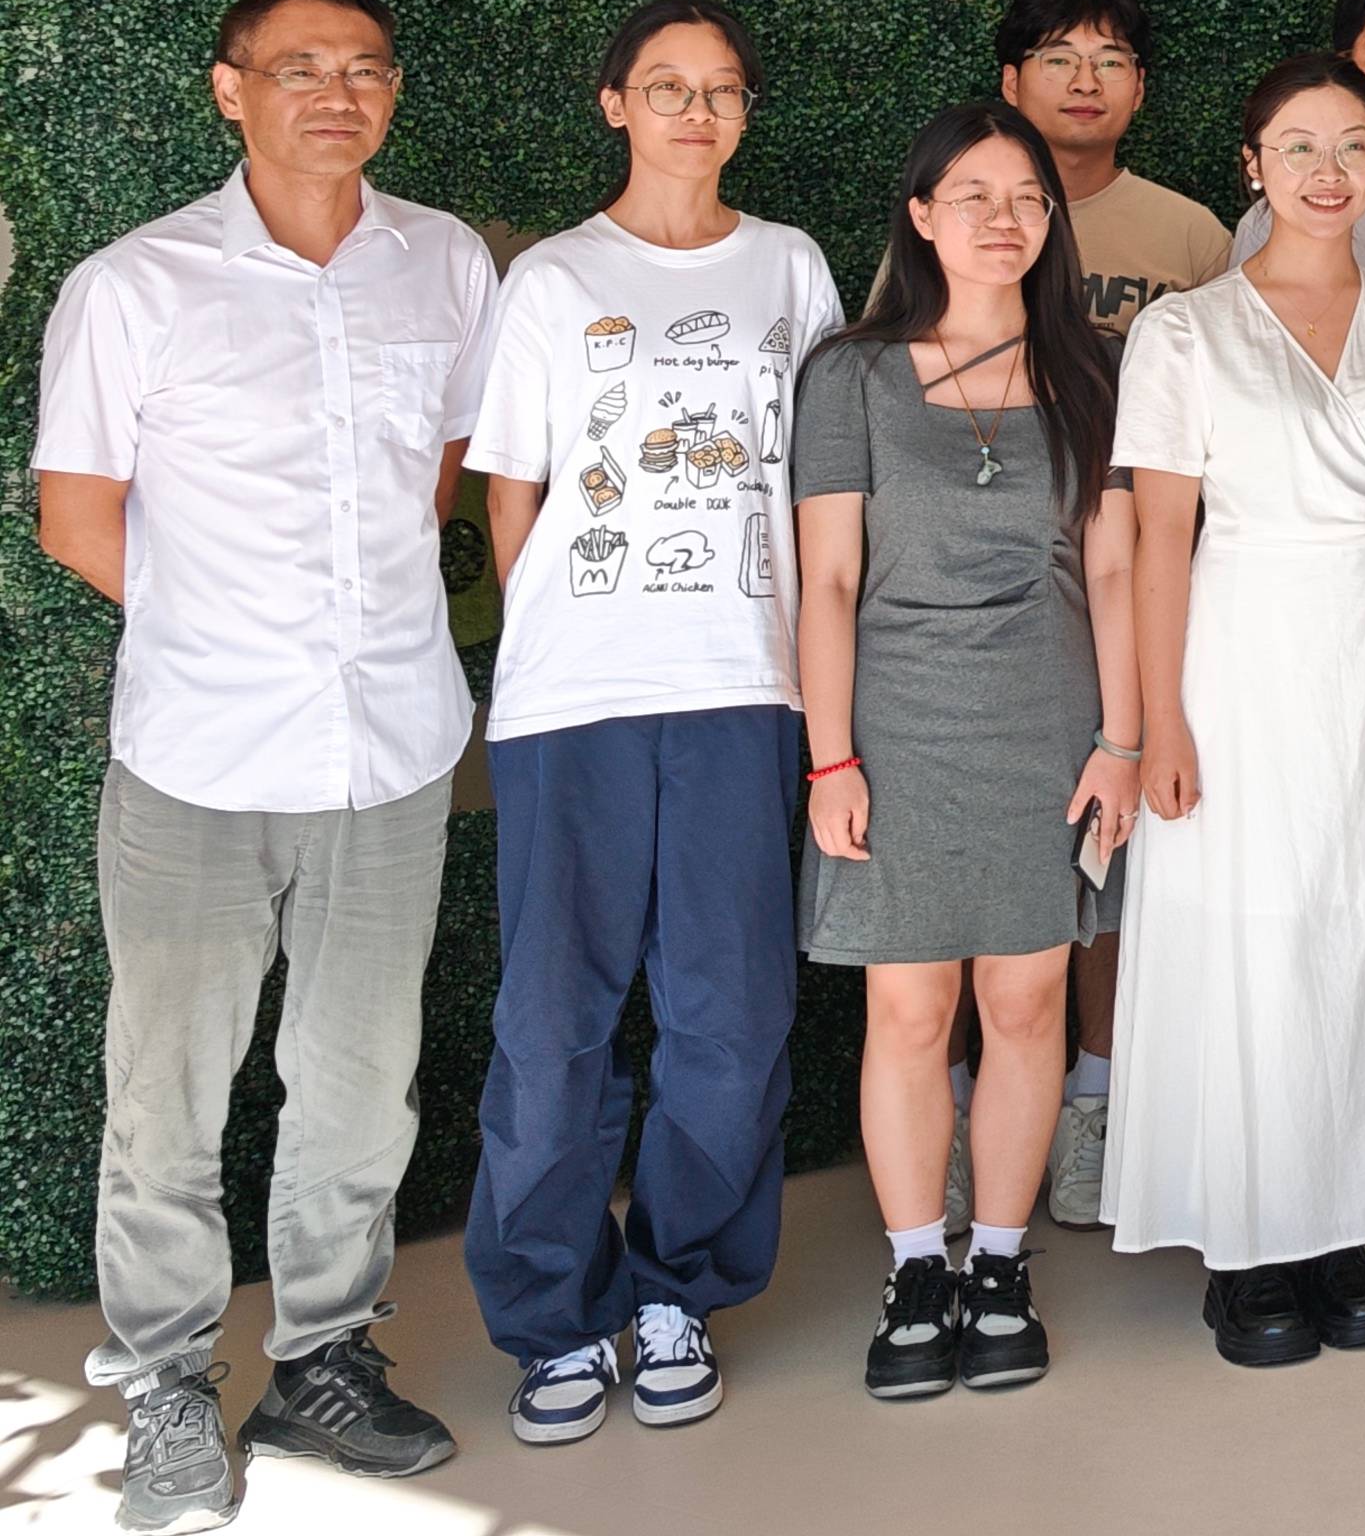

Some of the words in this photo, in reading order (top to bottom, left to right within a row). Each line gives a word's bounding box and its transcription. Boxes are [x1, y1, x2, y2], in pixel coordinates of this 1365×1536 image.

[654, 356, 679, 367] Hot
[682, 356, 704, 372] dog
[706, 356, 740, 372] burger
[654, 496, 697, 511] Double
[671, 581, 714, 593] Chicken
